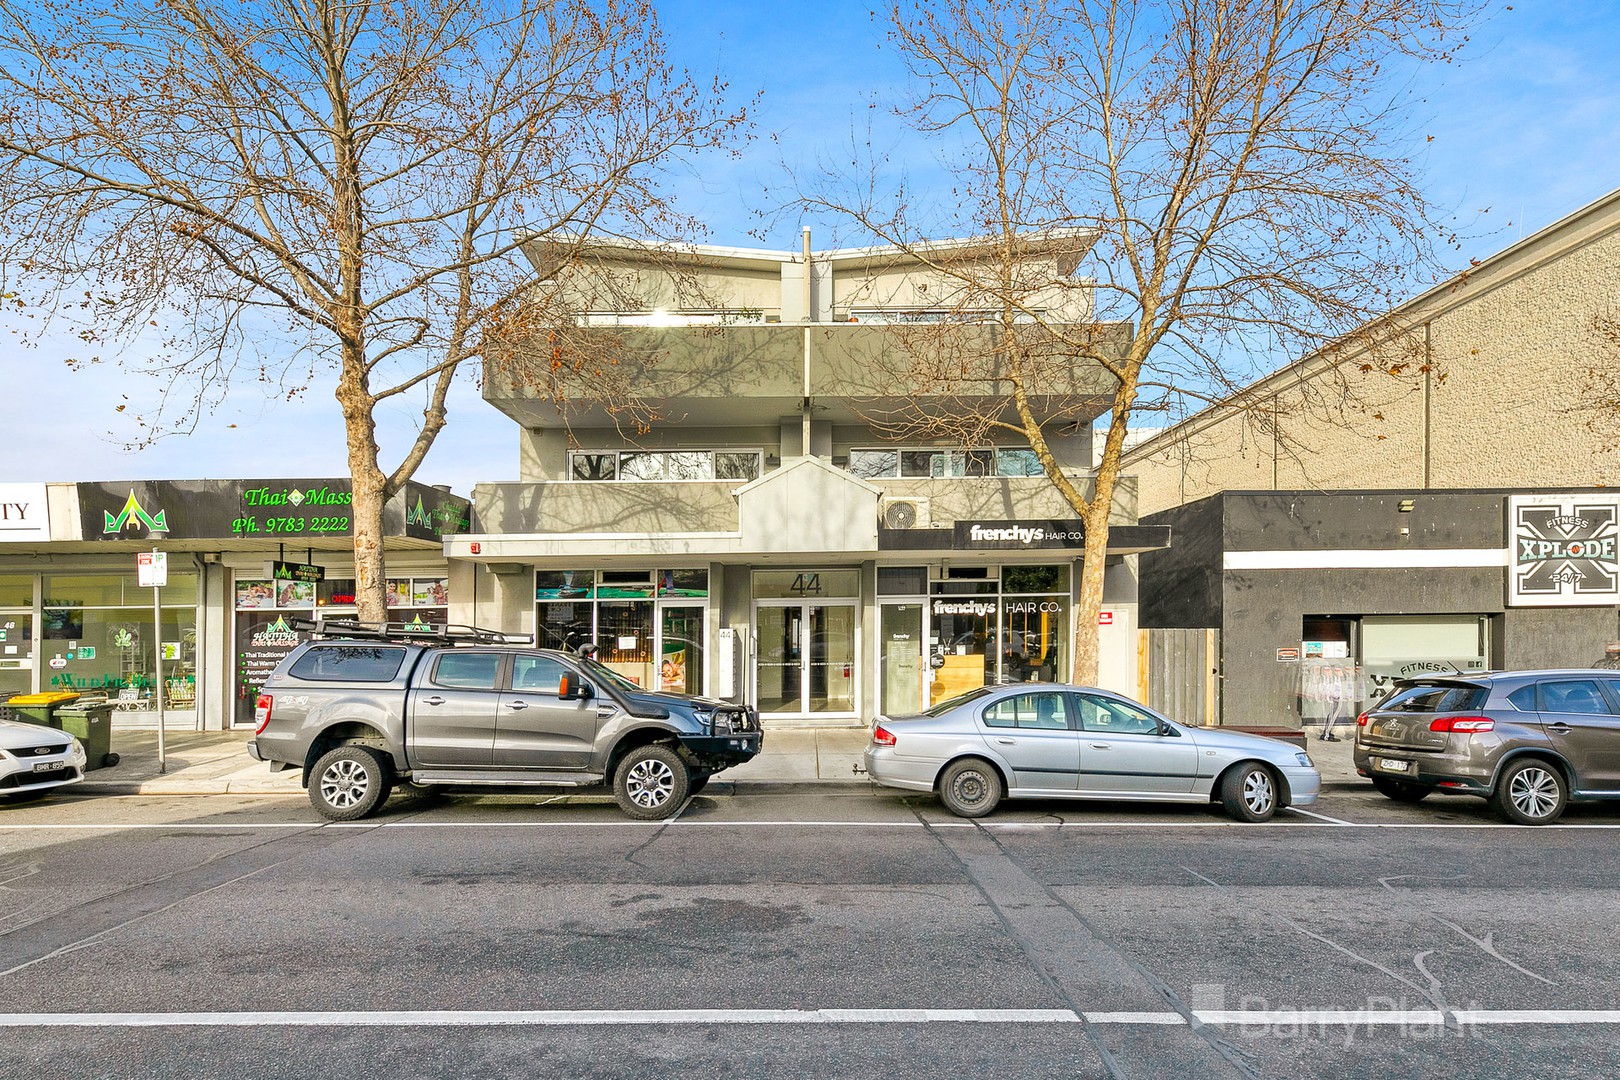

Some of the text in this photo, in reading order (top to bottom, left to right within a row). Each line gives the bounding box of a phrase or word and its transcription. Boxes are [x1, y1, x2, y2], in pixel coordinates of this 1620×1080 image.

[244, 487, 288, 506] Thai
[231, 516, 349, 533] Ph. 9783 2222
[1546, 516, 1590, 529] FITNESS
[970, 525, 1083, 544] frenchys HAIR CO.
[1519, 537, 1616, 561] XPLODE
[790, 573, 822, 594] 44
[1552, 573, 1583, 584] 24/7
[933, 600, 1062, 617] frenchys HAIR CO.
